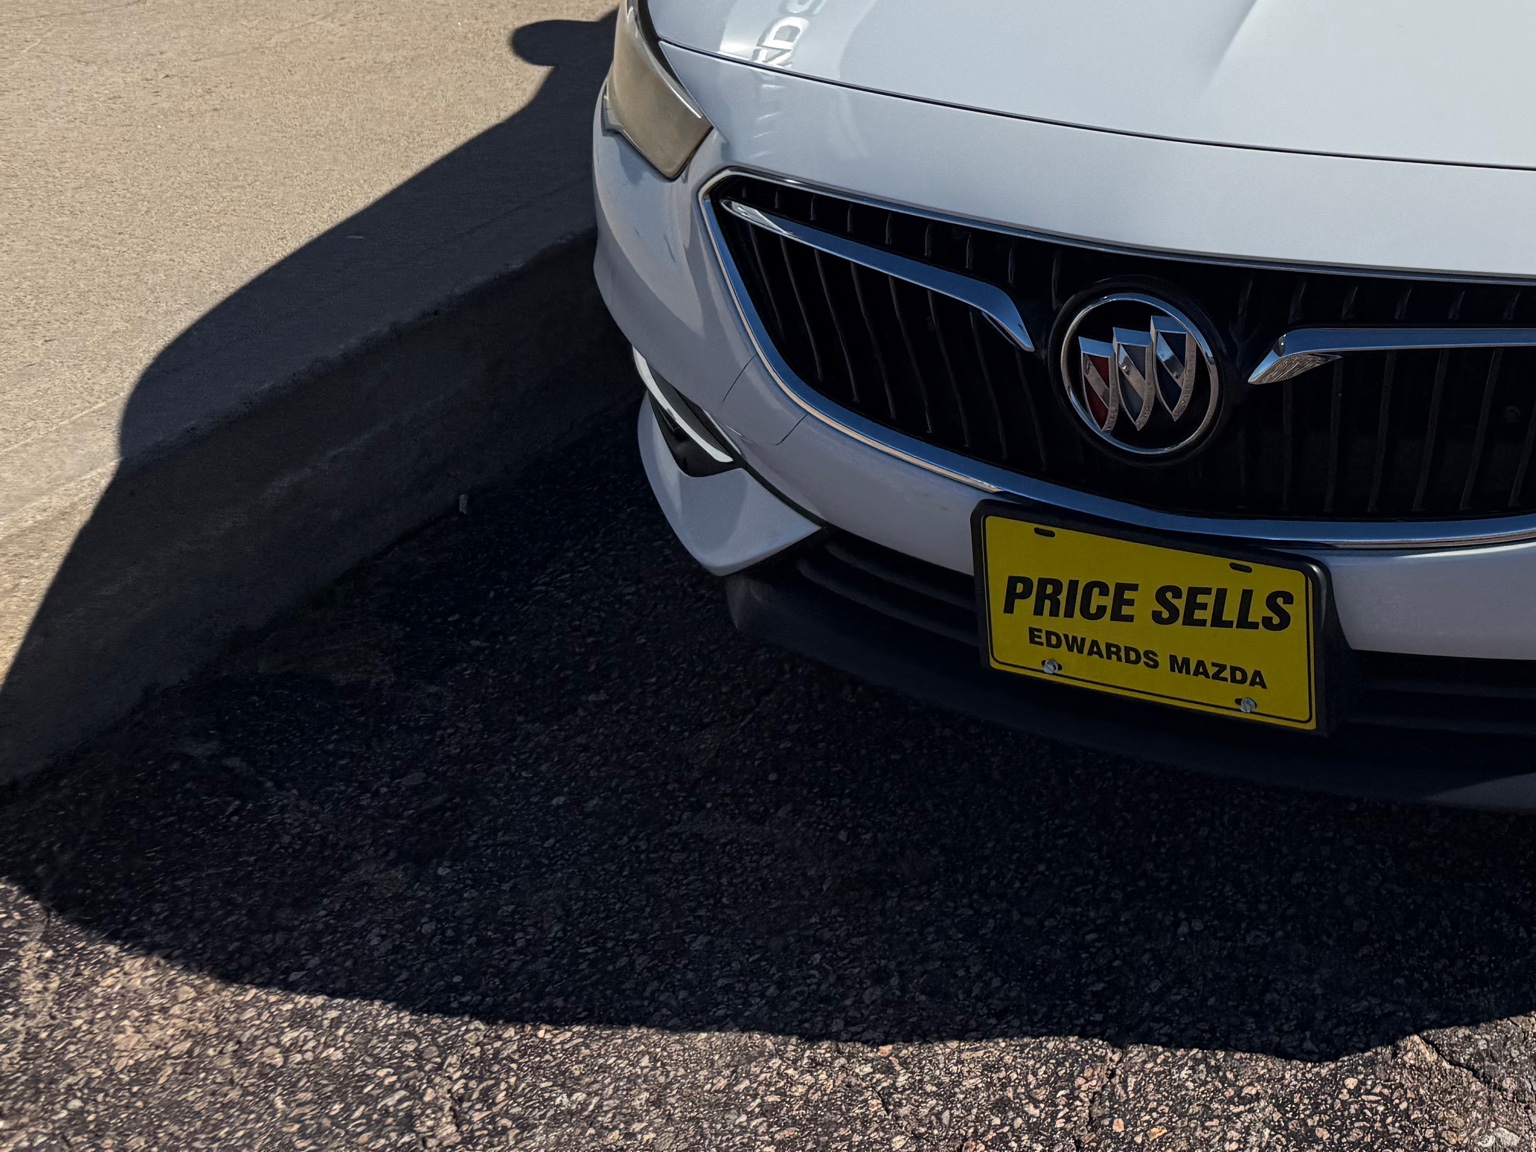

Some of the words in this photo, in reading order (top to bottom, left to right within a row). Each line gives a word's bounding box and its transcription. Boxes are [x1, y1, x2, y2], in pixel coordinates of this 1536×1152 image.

[1003, 575, 1140, 624] PRICE
[1151, 584, 1295, 632] SELLS
[1028, 626, 1160, 670] EDWARDS
[1168, 653, 1268, 690] MAZDA
